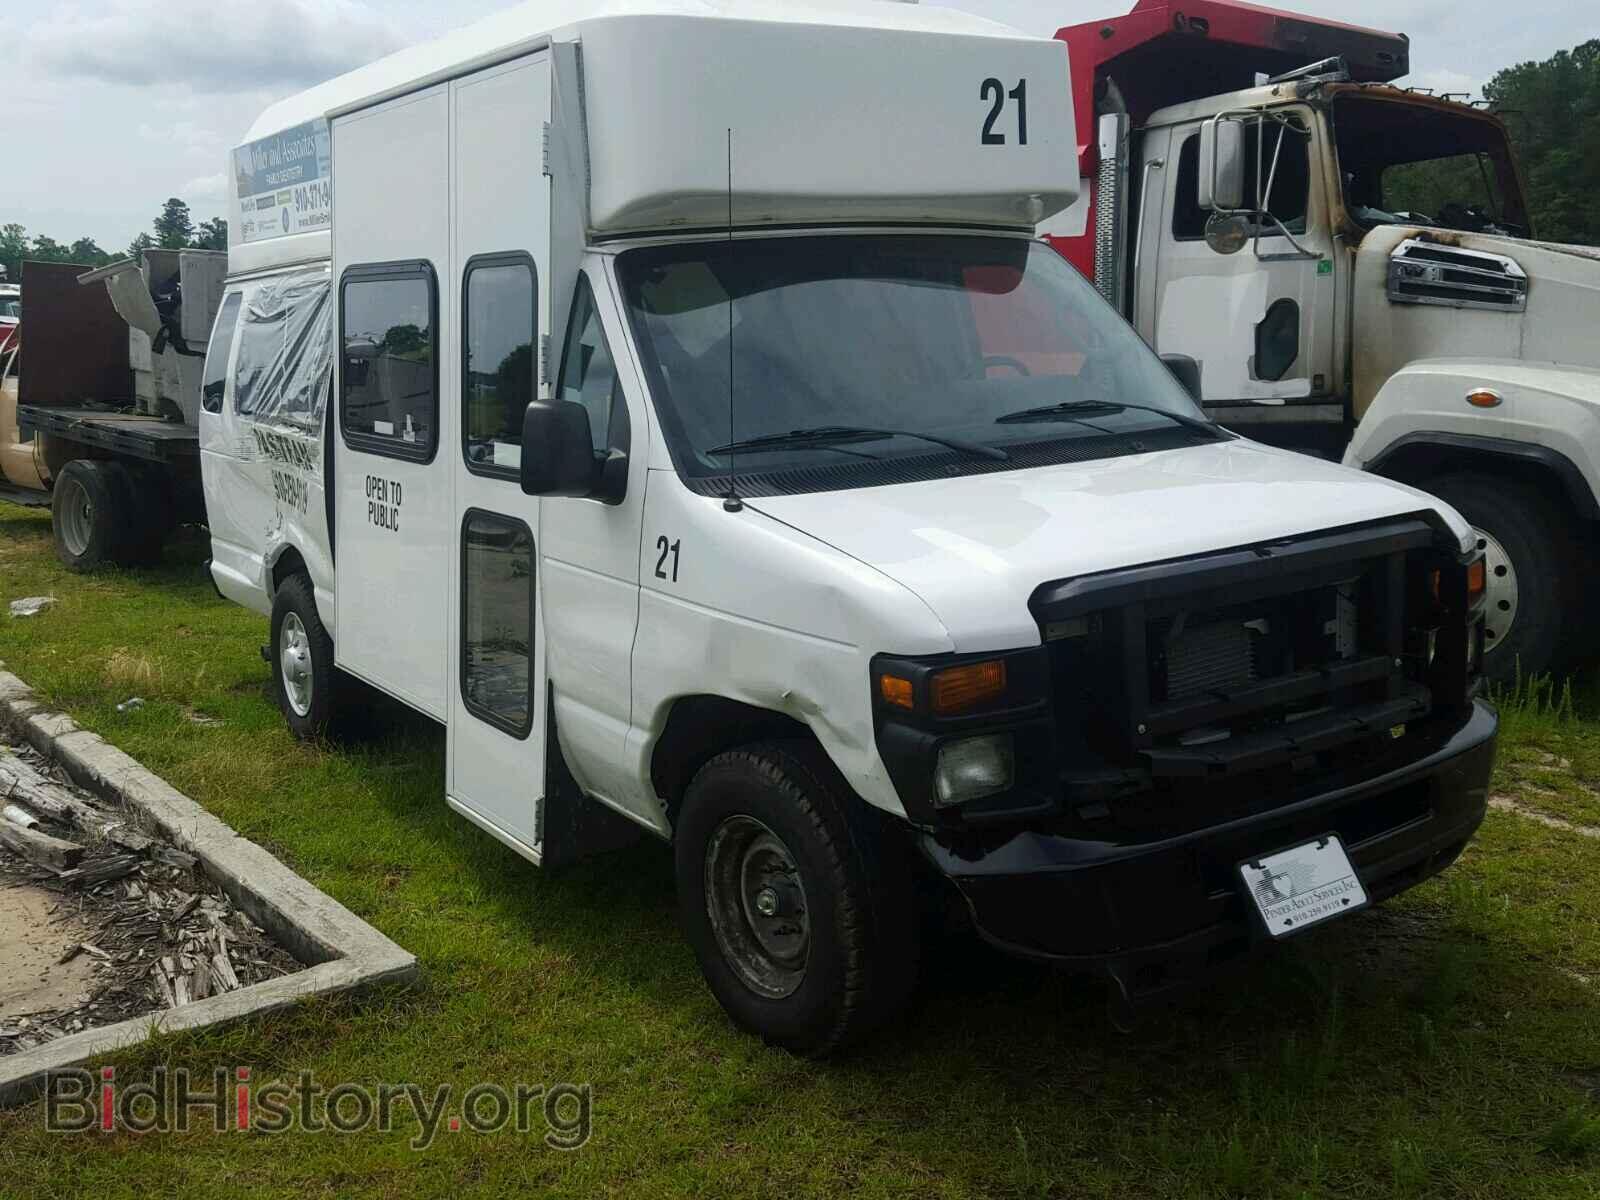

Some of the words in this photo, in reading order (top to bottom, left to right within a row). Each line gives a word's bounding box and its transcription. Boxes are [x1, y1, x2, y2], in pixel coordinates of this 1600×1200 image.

[980, 77, 1027, 145] 21
[366, 475, 388, 502] OPEN
[390, 481, 402, 506] TO
[368, 501, 399, 532] PUBLIC
[655, 535, 681, 582] 21
